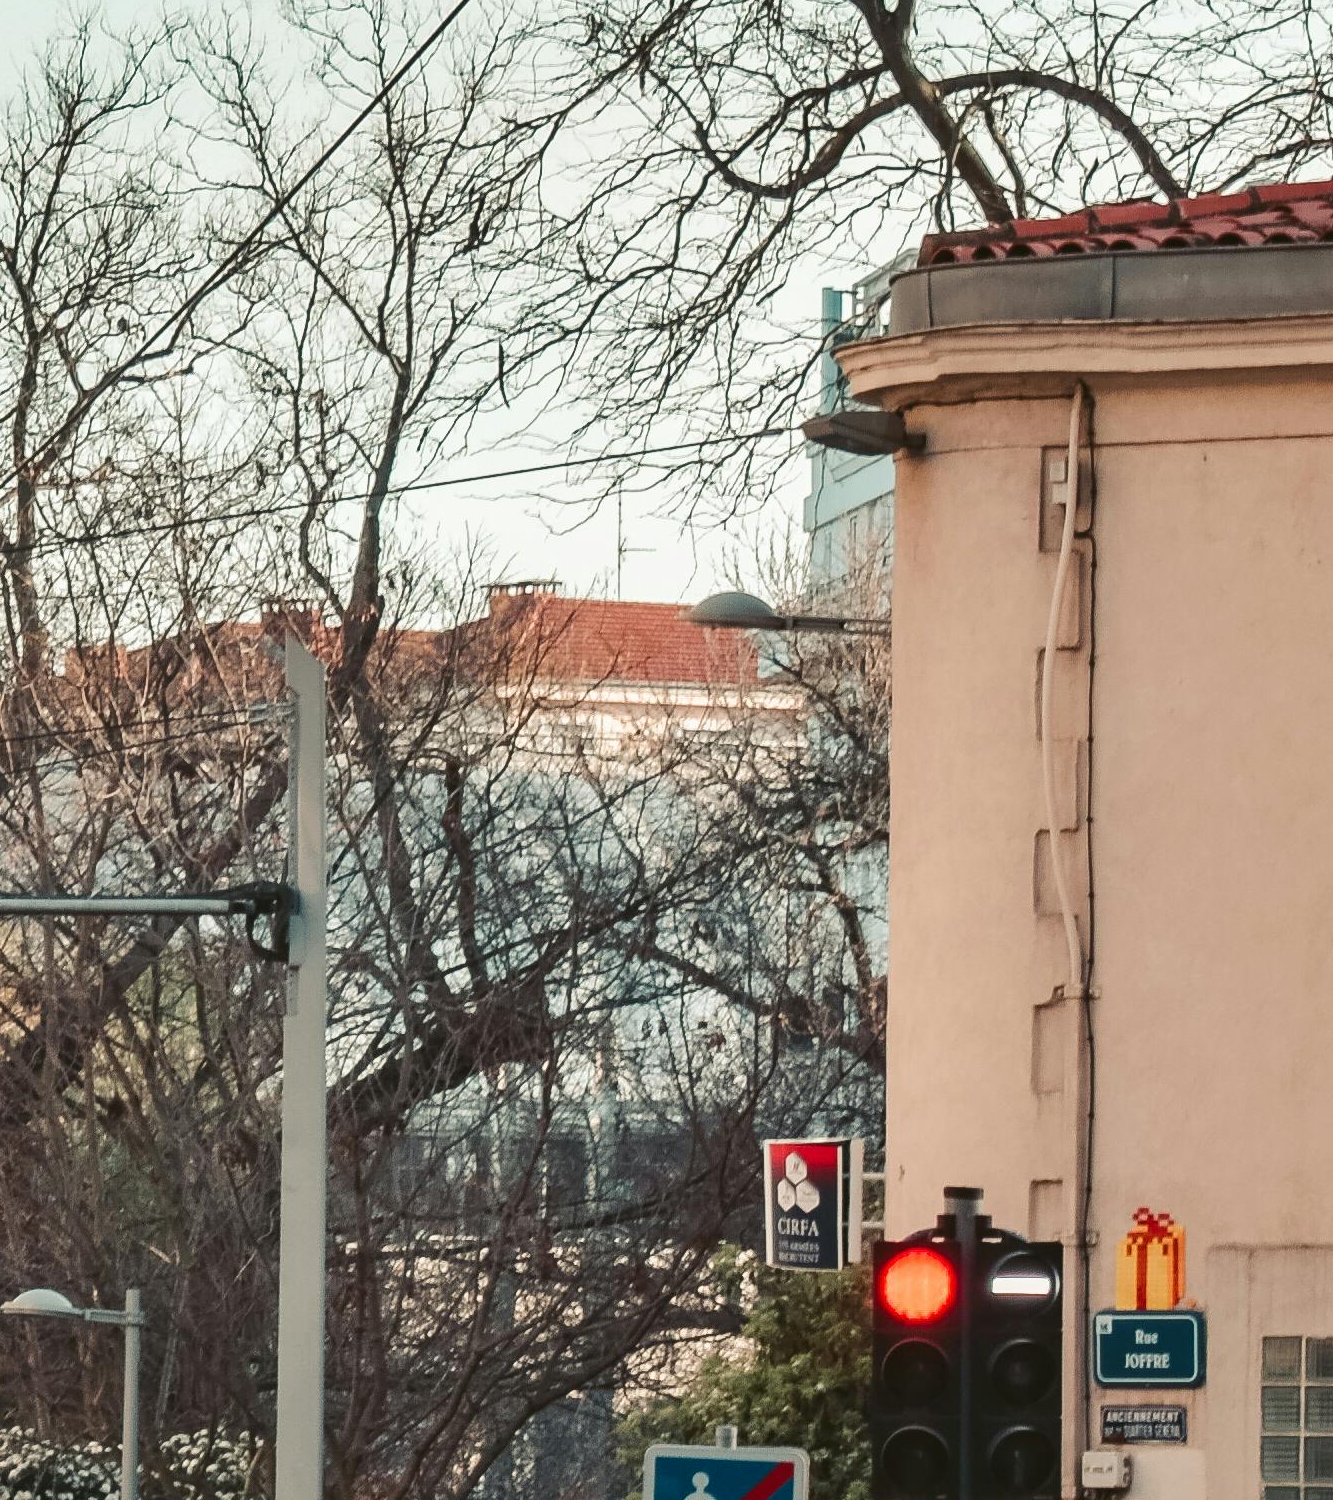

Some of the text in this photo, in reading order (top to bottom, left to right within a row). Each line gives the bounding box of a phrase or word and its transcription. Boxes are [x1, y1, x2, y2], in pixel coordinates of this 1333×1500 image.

[778, 1217, 820, 1237] CIRFA
[1135, 1329, 1158, 1345] Rue
[1124, 1352, 1170, 1369] JOFFRE
